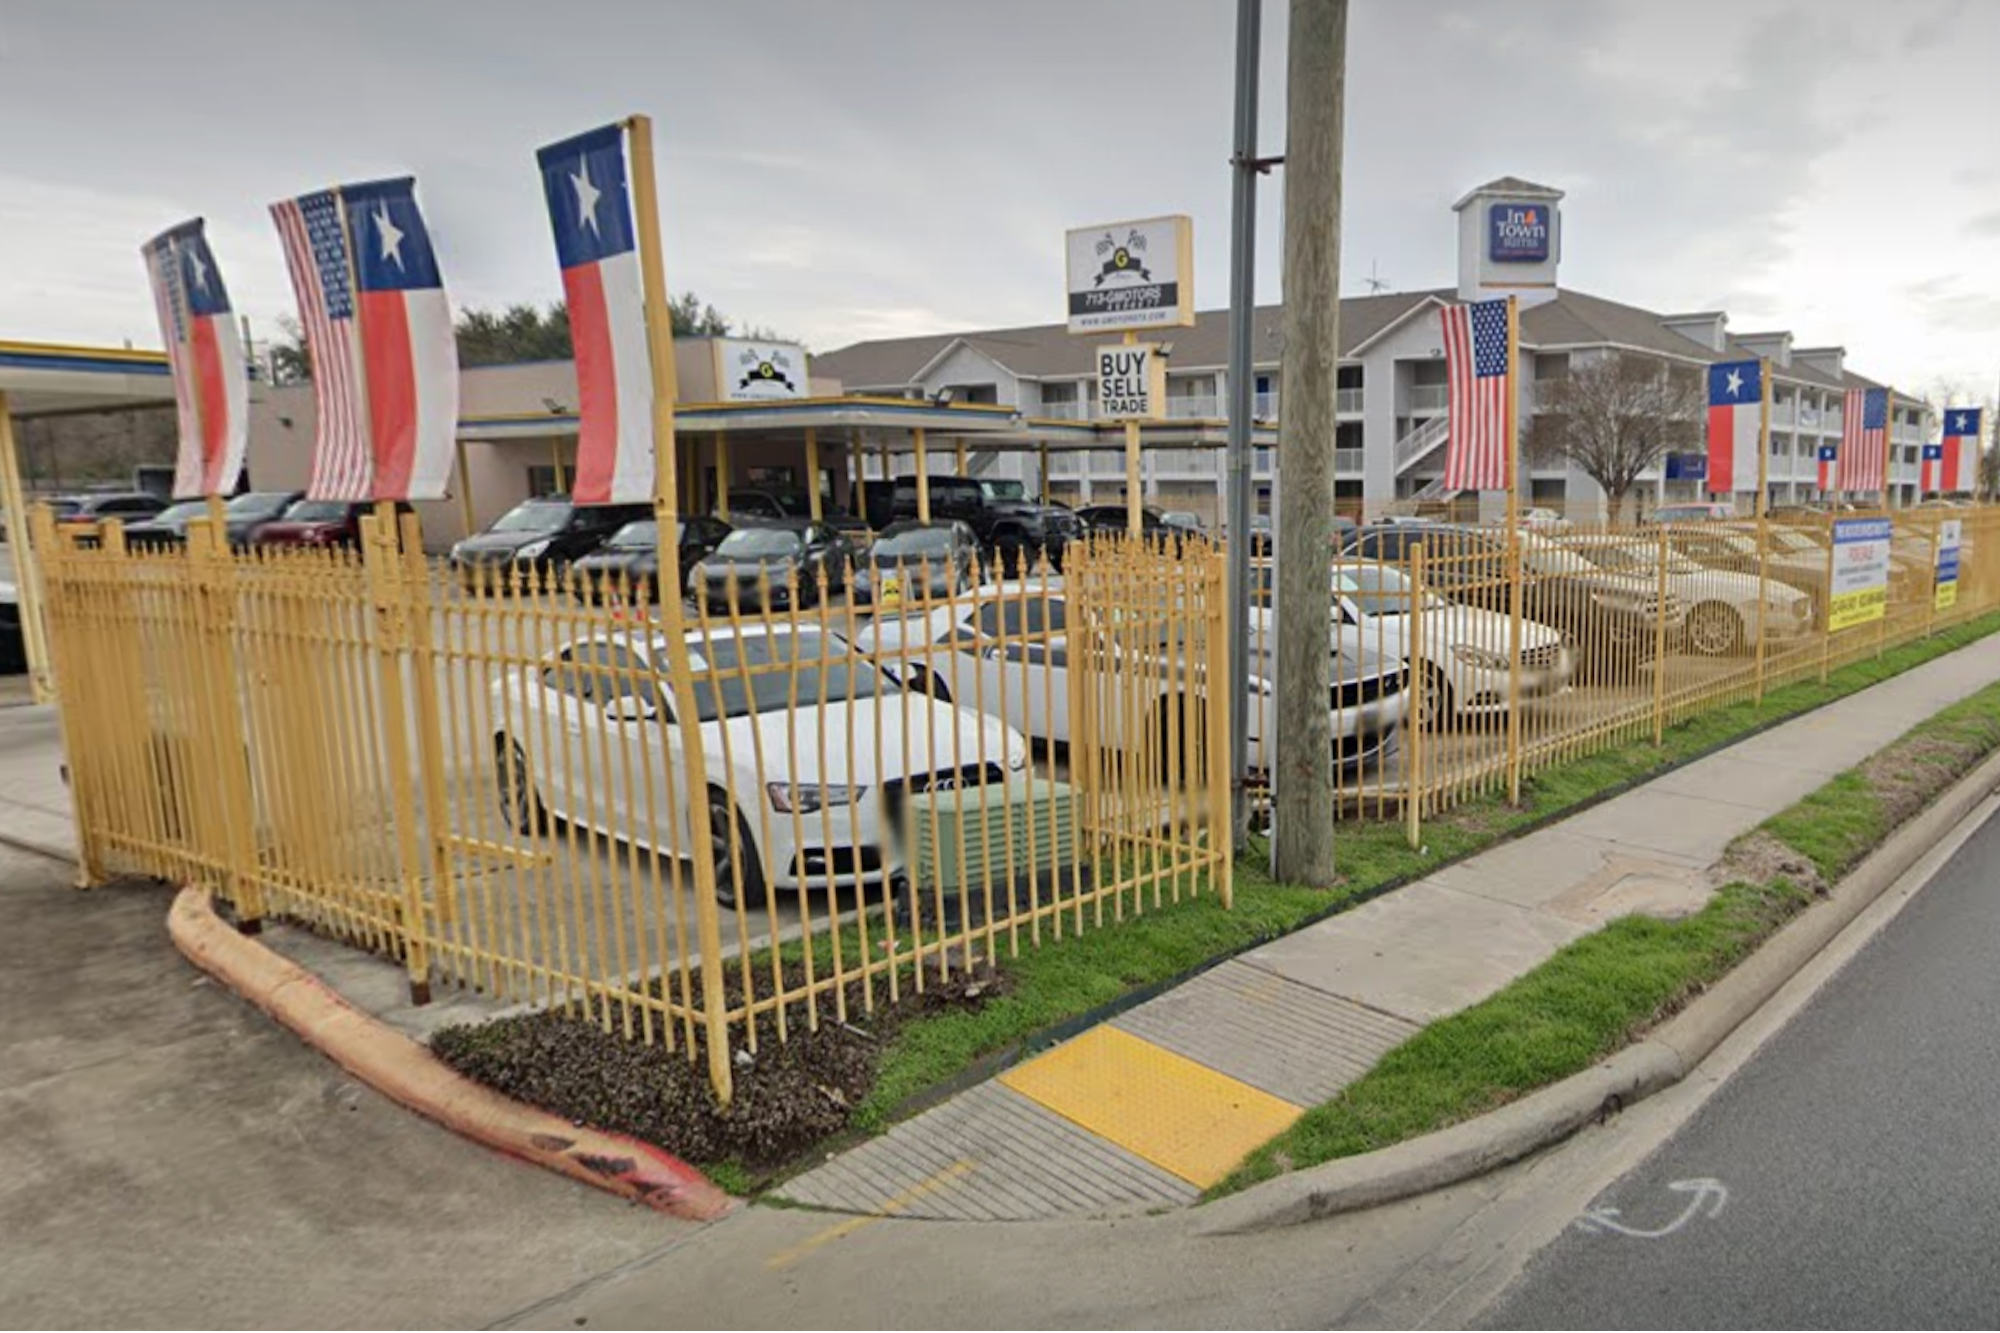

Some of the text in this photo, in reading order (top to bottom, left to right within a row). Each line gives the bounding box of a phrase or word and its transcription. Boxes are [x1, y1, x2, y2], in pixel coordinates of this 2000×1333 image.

[1507, 208, 1525, 224] In
[1115, 250, 1128, 268] G
[1101, 352, 1146, 377] BUY
[1102, 378, 1148, 398] SELL
[1102, 399, 1149, 414] TRADE
